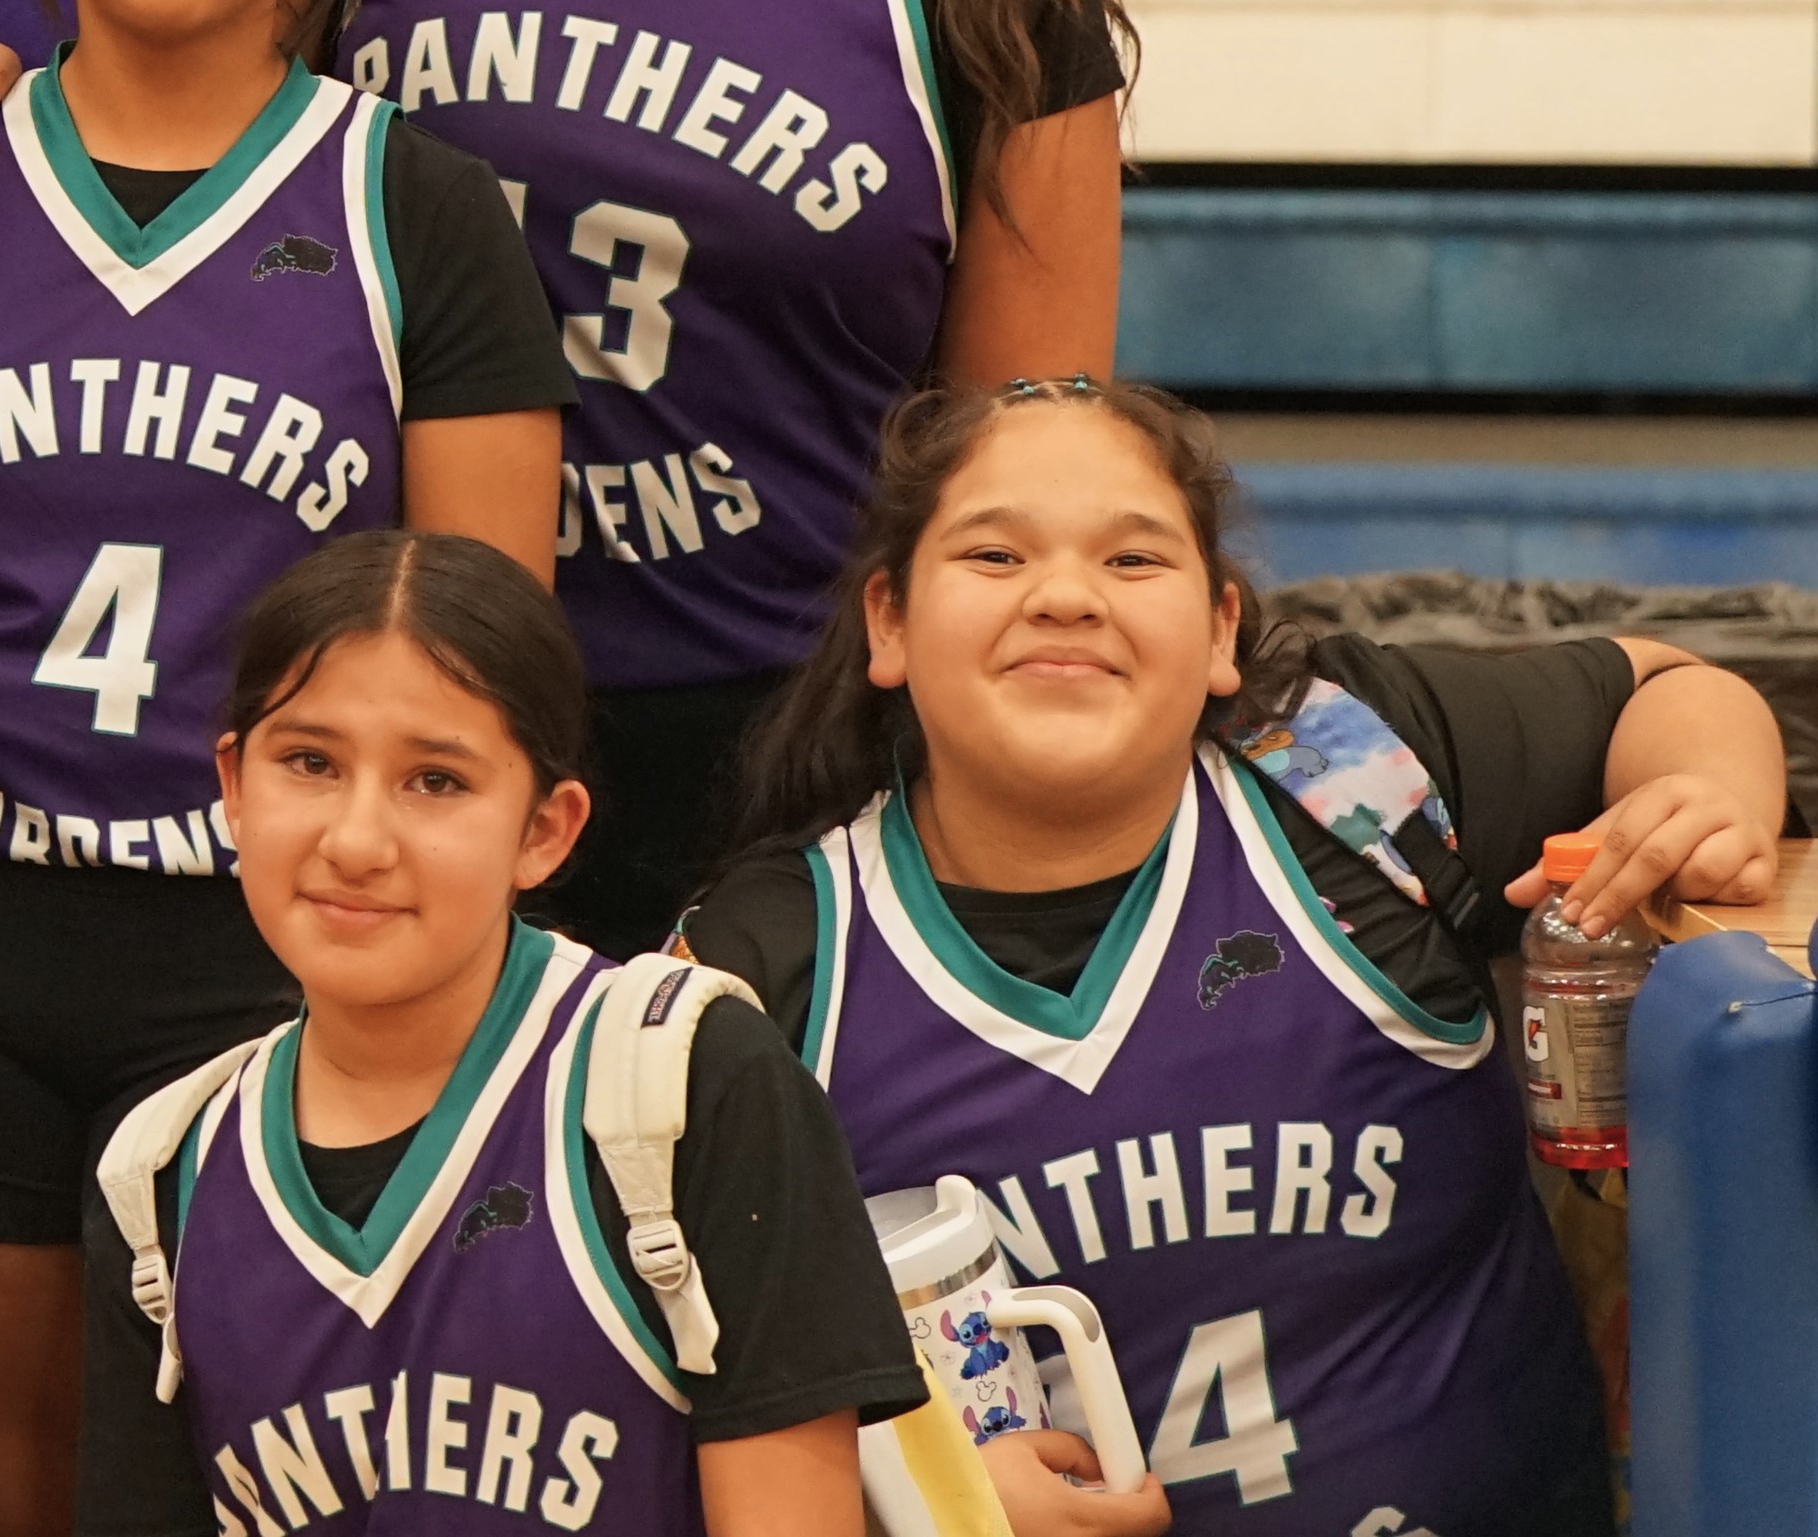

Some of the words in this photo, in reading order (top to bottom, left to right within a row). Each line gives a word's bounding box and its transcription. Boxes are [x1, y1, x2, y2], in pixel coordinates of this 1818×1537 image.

[352, 11, 889, 235] PANTHERS
[499, 178, 692, 394] 3
[32, 541, 164, 738] 4
[976, 1121, 1405, 1281] NTHERS
[213, 1369, 620, 1537] ANTERS
